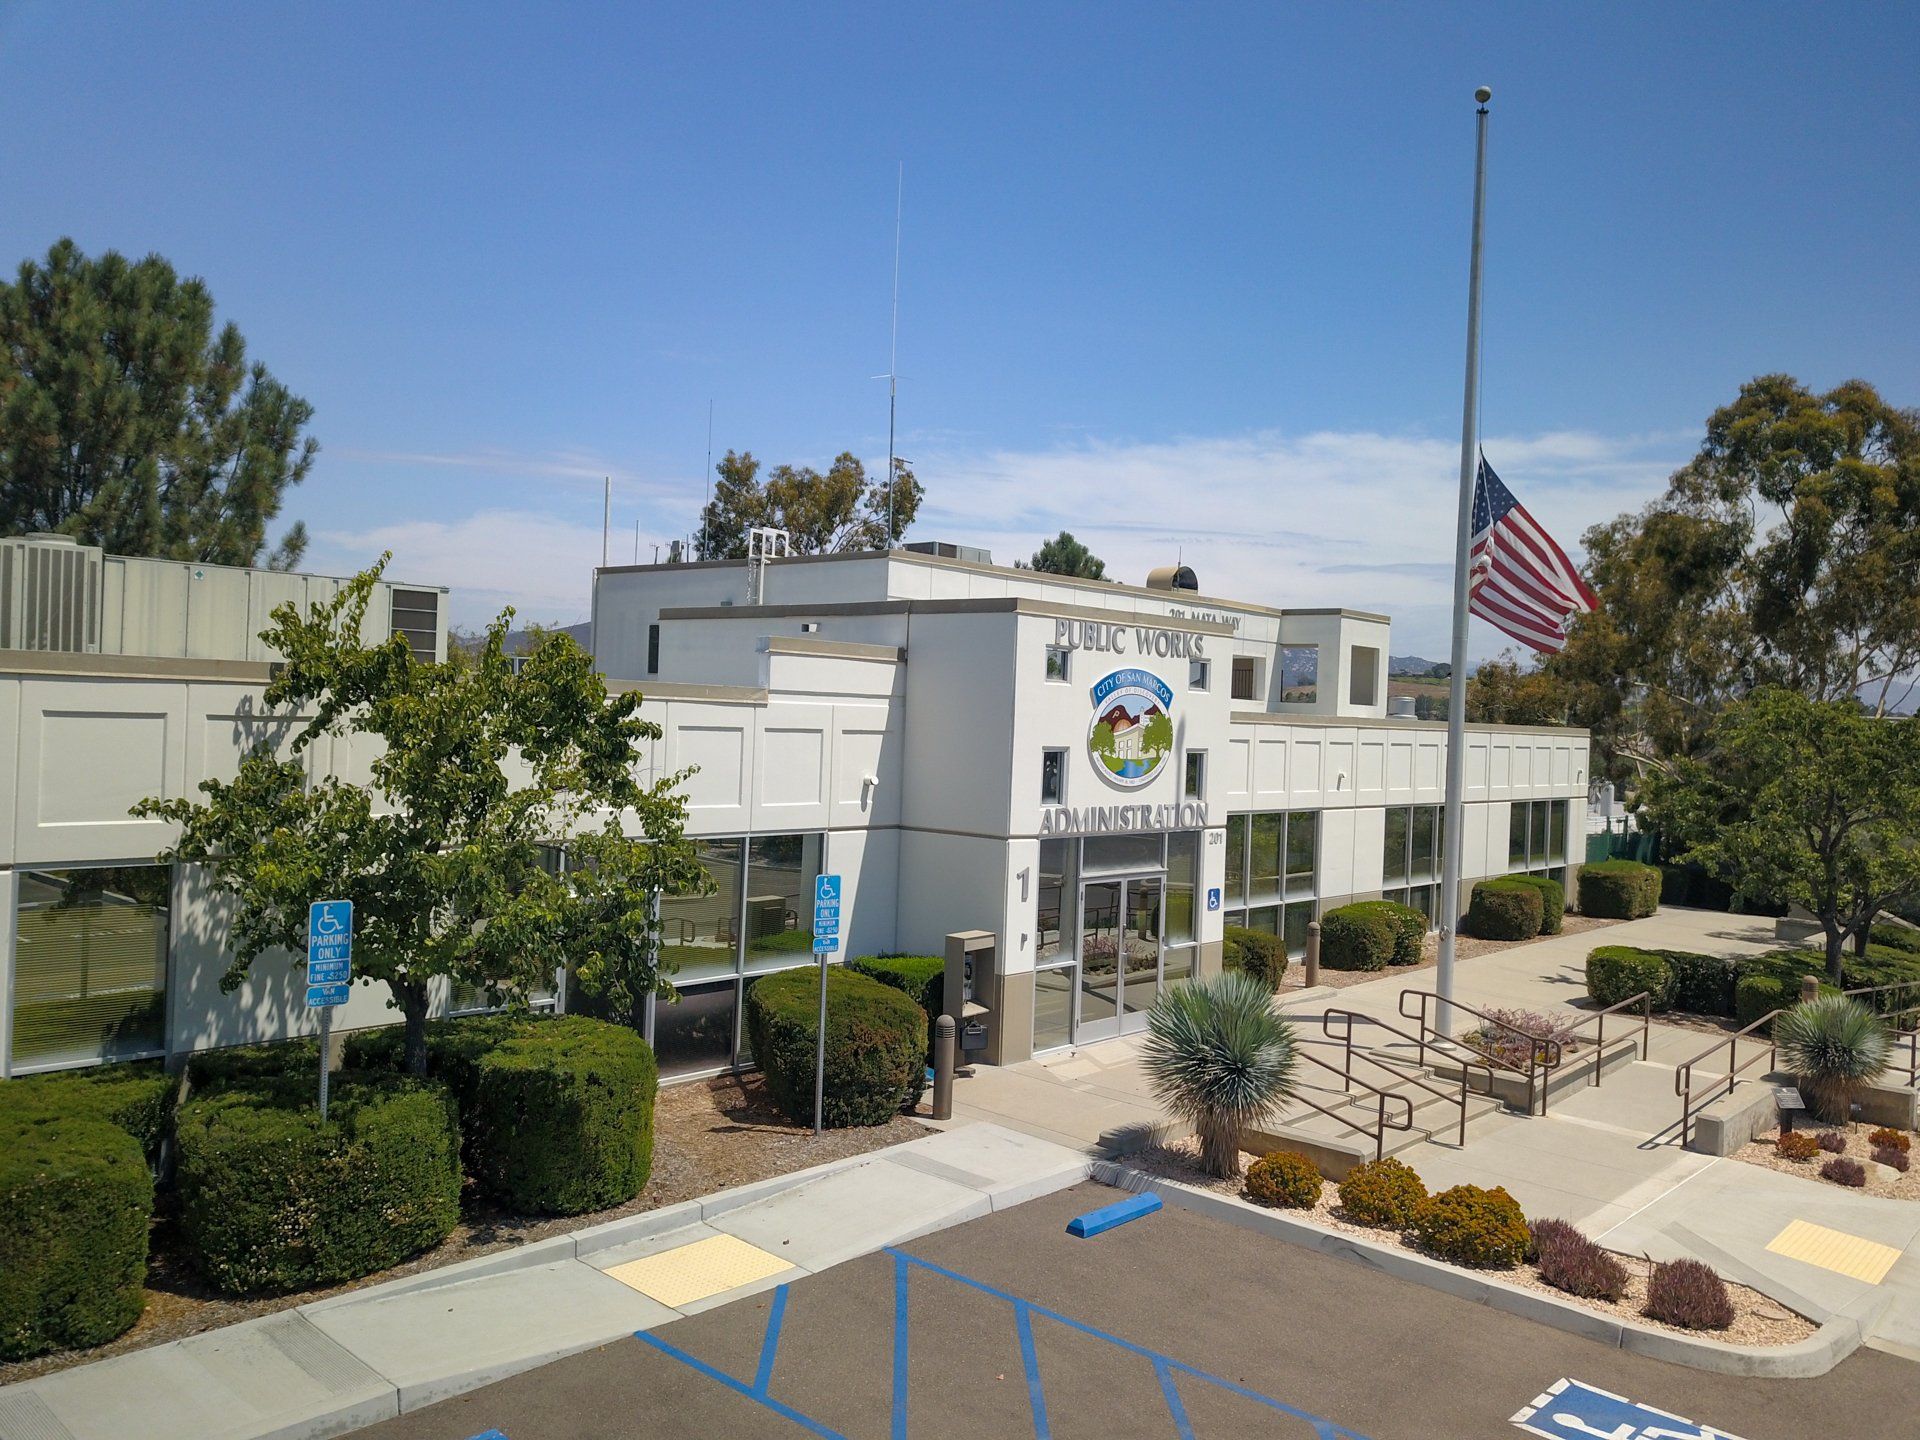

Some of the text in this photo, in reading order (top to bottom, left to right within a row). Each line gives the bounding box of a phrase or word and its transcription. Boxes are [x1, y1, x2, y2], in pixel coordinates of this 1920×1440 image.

[1191, 611, 1217, 623] MATA
[1221, 615, 1242, 631] WAY
[1055, 618, 1204, 658] PUBLIC WORKS
[1097, 672, 1171, 702] CITY OF SAN MARCOS
[1040, 802, 1208, 834] ADMINISTRATION
[1208, 832, 1223, 845] 201
[817, 899, 838, 908] PARKING
[820, 908, 834, 918] ONLY
[311, 933, 349, 947] PARKING
[318, 947, 341, 959] ONLY
[315, 962, 343, 971] MINIMUM
[310, 973, 325, 982] FINE
[308, 995, 348, 1006] ACCESSIBLE
